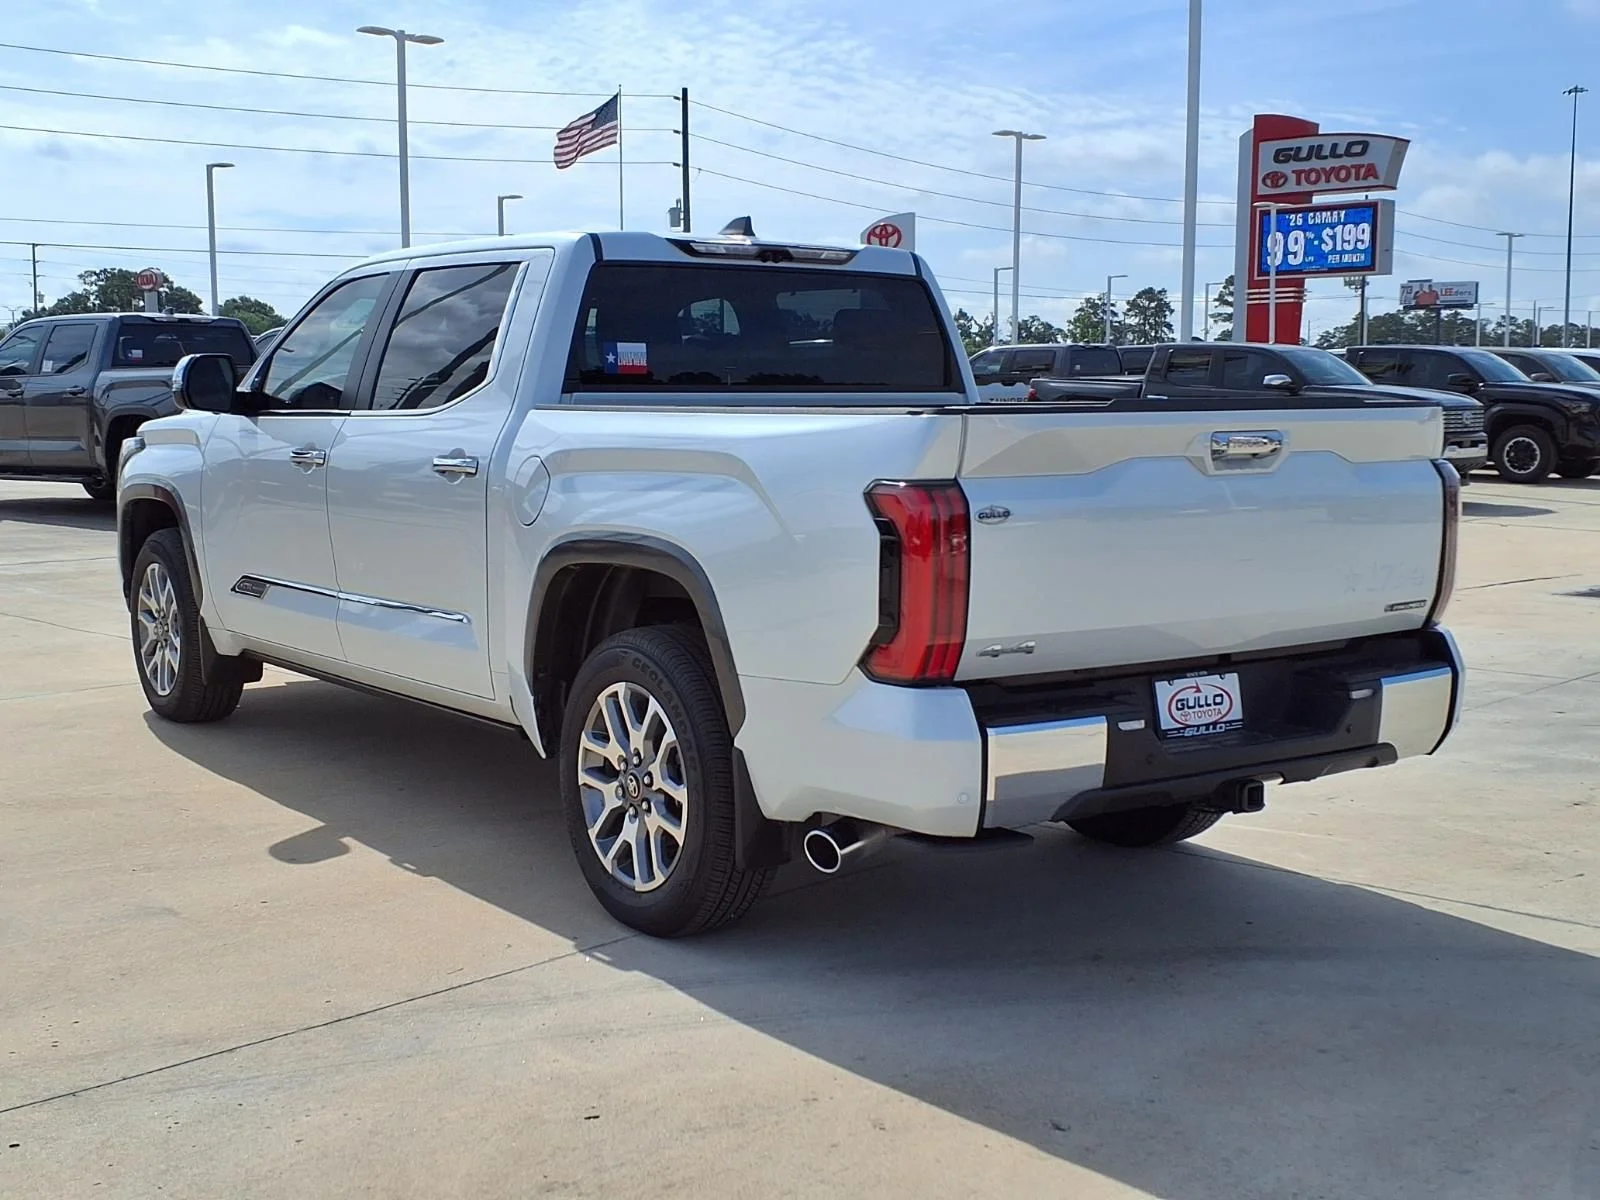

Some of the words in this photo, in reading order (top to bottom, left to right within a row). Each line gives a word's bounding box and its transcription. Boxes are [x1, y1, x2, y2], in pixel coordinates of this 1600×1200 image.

[1273, 140, 1370, 164] GULLO
[1291, 163, 1379, 186] TOYOTA
[1321, 222, 1371, 253] $199
[1176, 693, 1224, 711] GULLO
[1192, 708, 1223, 719] TOYOTA
[1184, 724, 1226, 736] GULLO
